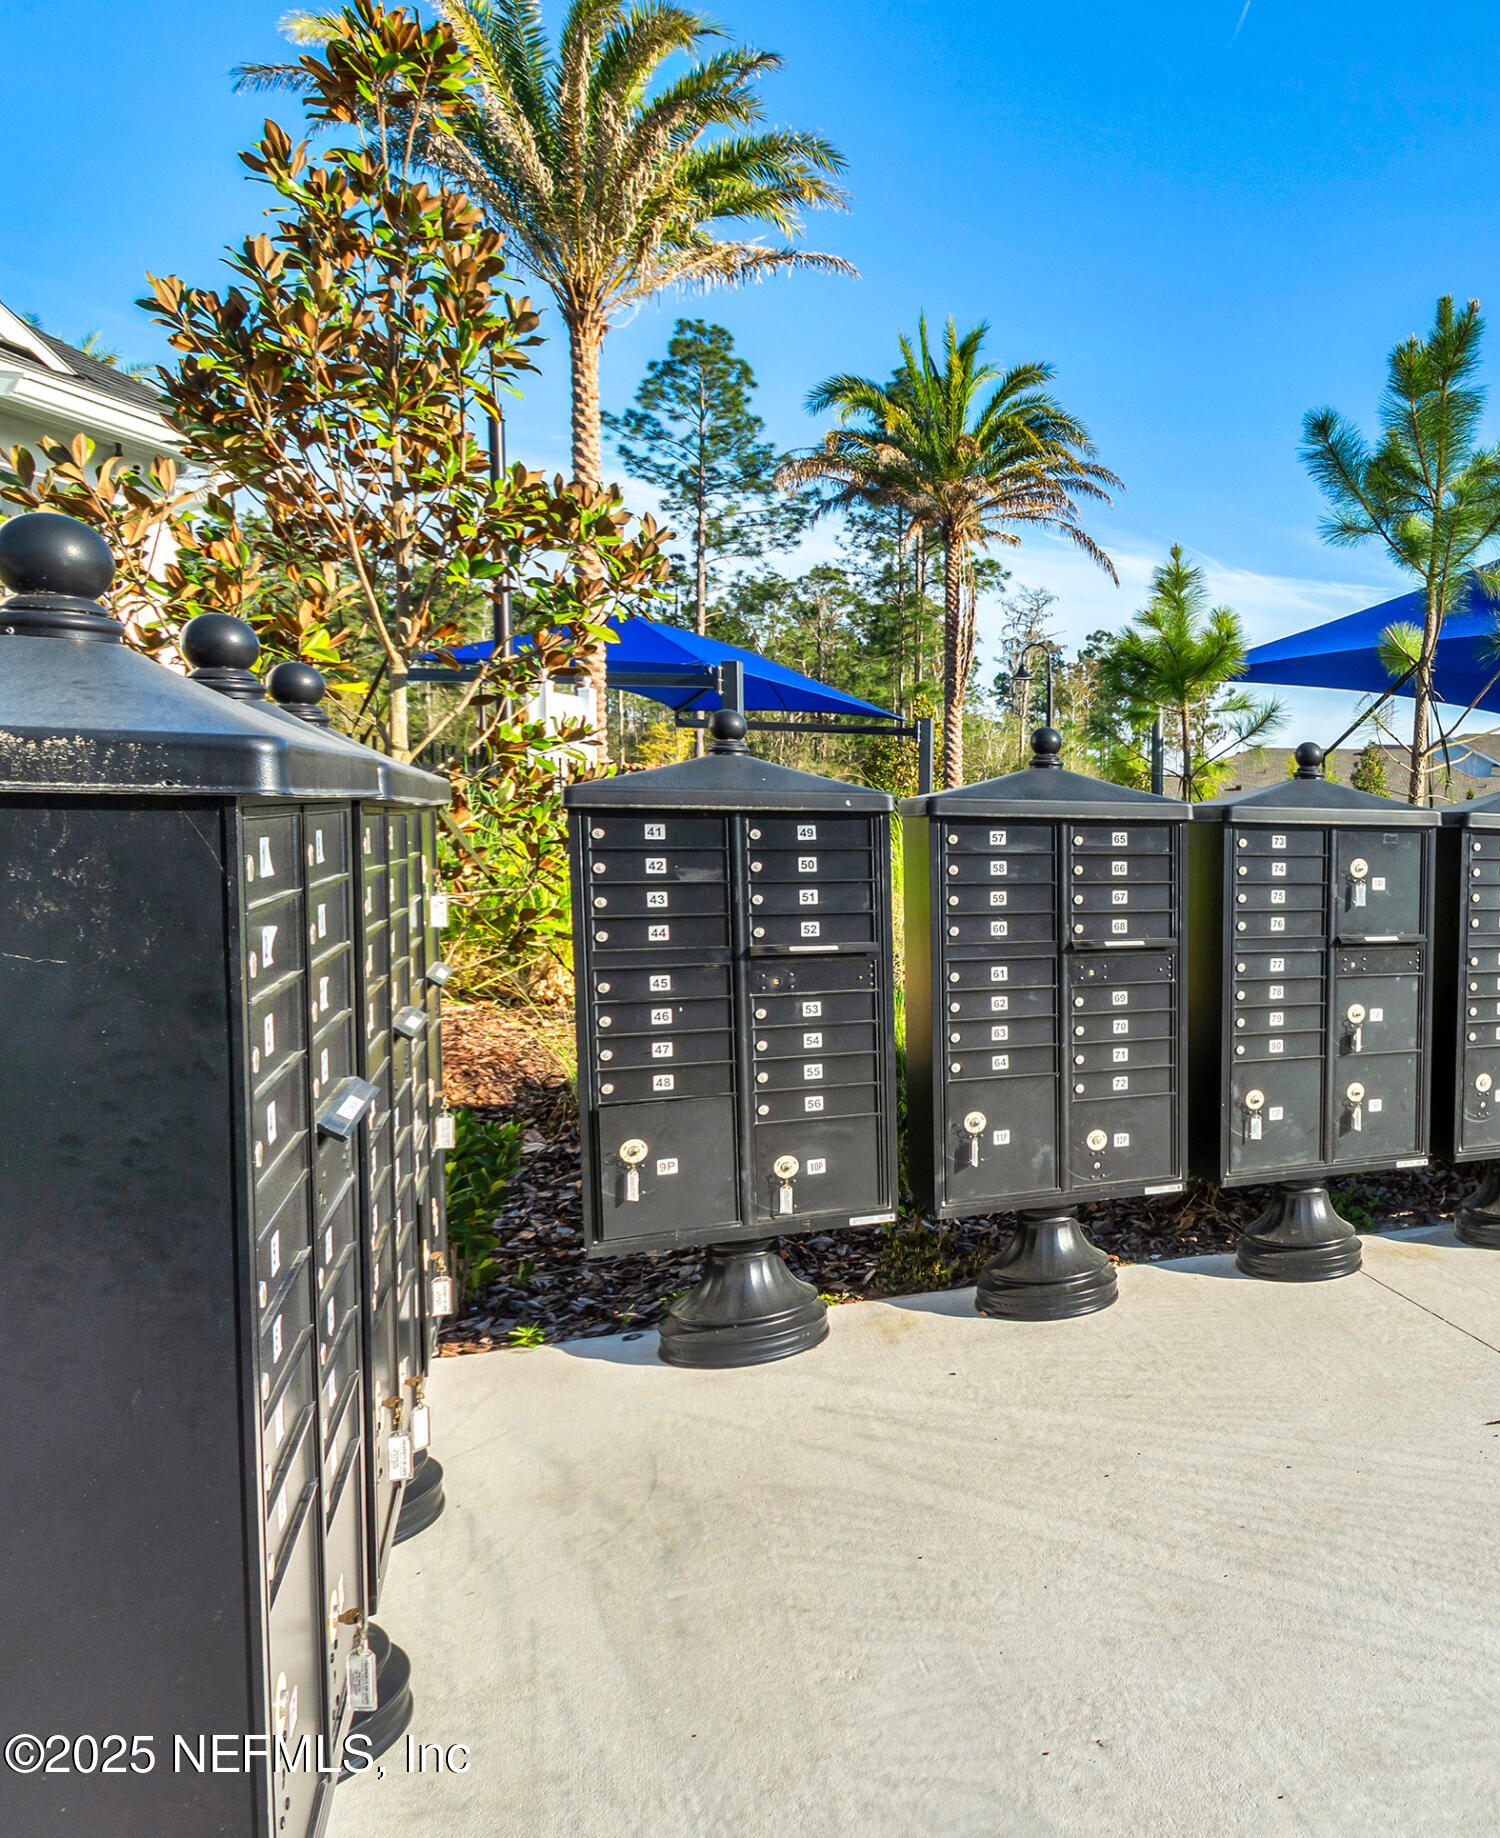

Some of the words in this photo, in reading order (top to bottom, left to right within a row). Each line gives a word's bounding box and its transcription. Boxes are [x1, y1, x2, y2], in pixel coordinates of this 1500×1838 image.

[647, 826, 661, 837] 41
[799, 828, 814, 838] 49
[991, 833, 1004, 843] 57
[1113, 834, 1126, 844] 65
[1273, 837, 1285, 846] 73
[648, 860, 664, 871] 42
[801, 859, 815, 870] 50
[992, 863, 1005, 873] 58
[1113, 863, 1126, 873] 66
[1274, 864, 1284, 873] 74
[649, 894, 665, 905] 43
[801, 892, 815, 903] 51
[992, 893, 1005, 904] 59
[1113, 892, 1126, 902] 67
[1273, 891, 1284, 901] 75
[1113, 922, 1126, 931] 68
[1273, 919, 1283, 928] 76
[650, 928, 667, 938] 44
[803, 924, 817, 935] 52
[992, 924, 1006, 934] 60
[1272, 960, 1283, 969] 77
[993, 969, 1005, 979] 61
[652, 978, 668, 989] 45
[1272, 987, 1282, 997] 78
[1114, 993, 1126, 1003] 69
[993, 998, 1006, 1009] 62
[805, 1004, 819, 1014] 53
[653, 1011, 670, 1022] 46
[1272, 1014, 1282, 1023] 79
[1115, 1022, 1127, 1031] 70
[993, 1028, 1006, 1038] 63
[806, 1036, 820, 1046] 54
[654, 1044, 670, 1055] 47
[1114, 1050, 1126, 1059] 71
[994, 1058, 1007, 1068] 64
[806, 1066, 821, 1077] 55
[655, 1077, 671, 1088] 48
[1115, 1078, 1127, 1088] 72
[807, 1098, 821, 1109] 56
[659, 1161, 676, 1172] 9P
[810, 1161, 823, 1172] 10P
